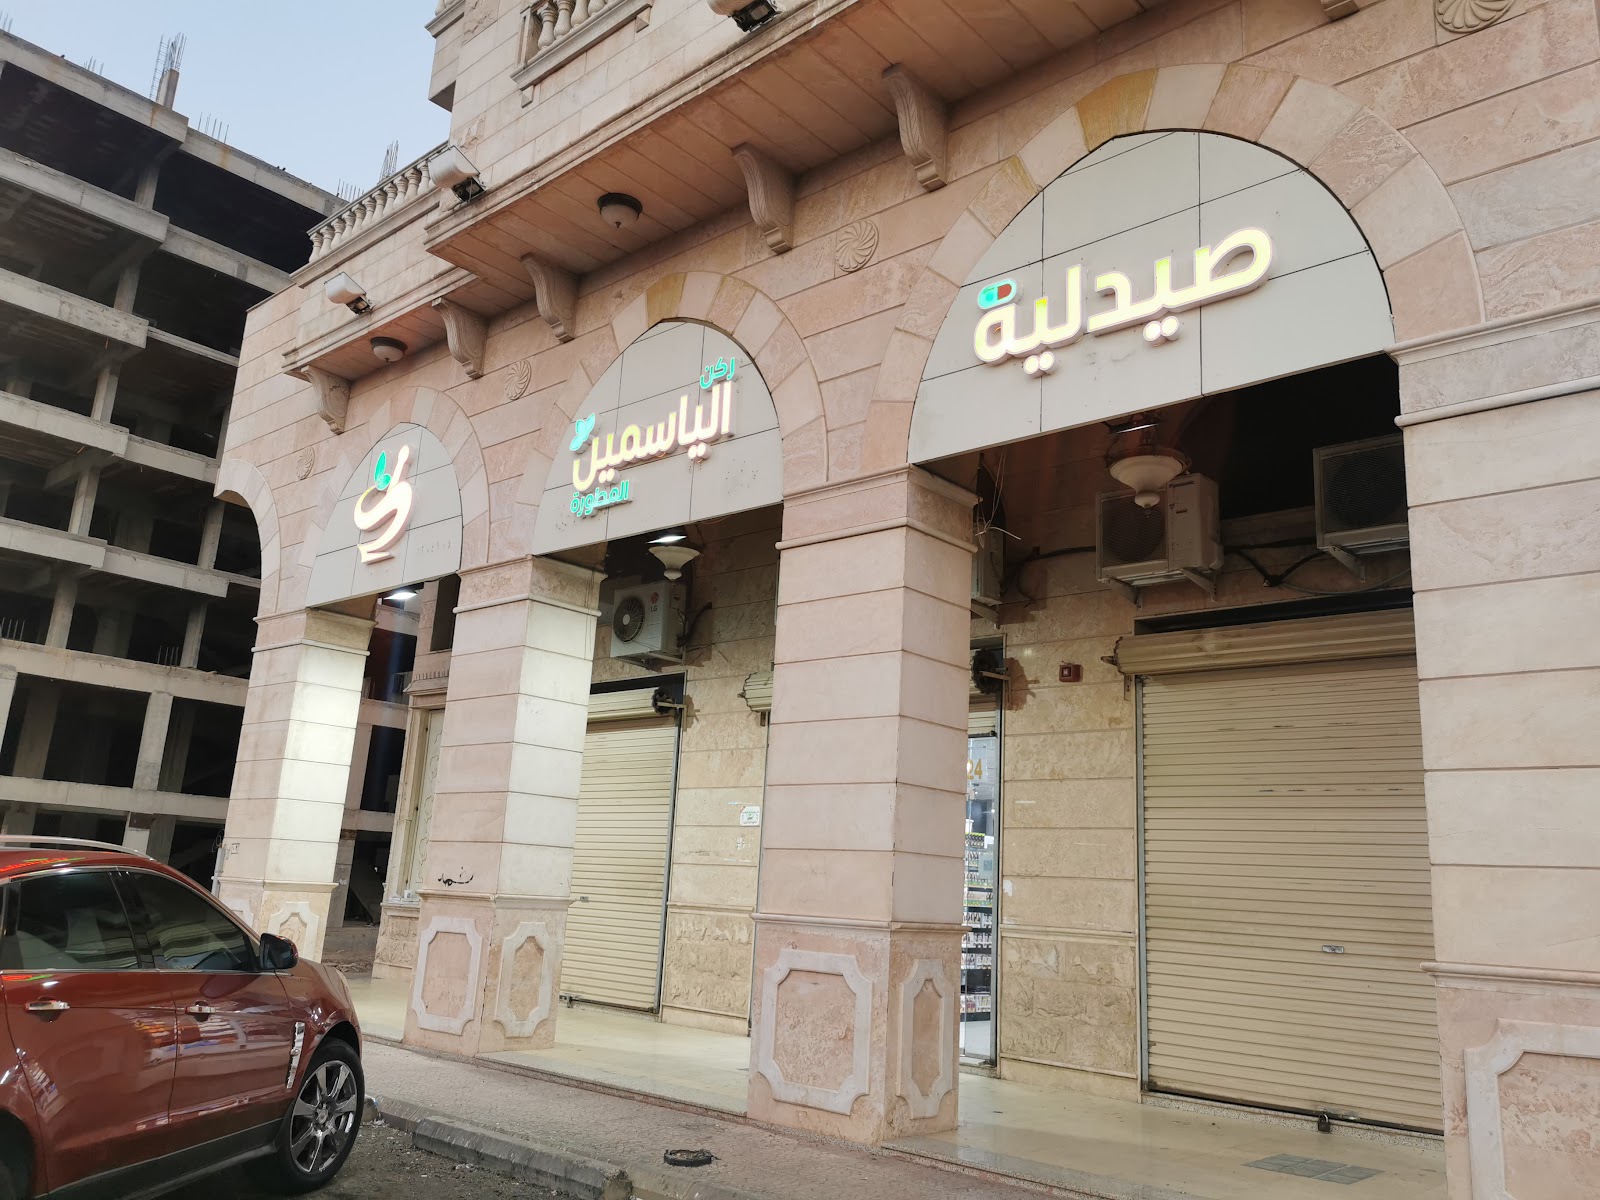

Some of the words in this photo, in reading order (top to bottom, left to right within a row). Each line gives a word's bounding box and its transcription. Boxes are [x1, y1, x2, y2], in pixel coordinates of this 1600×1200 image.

[973, 226, 1274, 377] صيدلية
[700, 357, 735, 389] ركن
[571, 380, 735, 492] الياسمين
[570, 480, 629, 517] المطورة
[966, 758, 983, 780] 24
